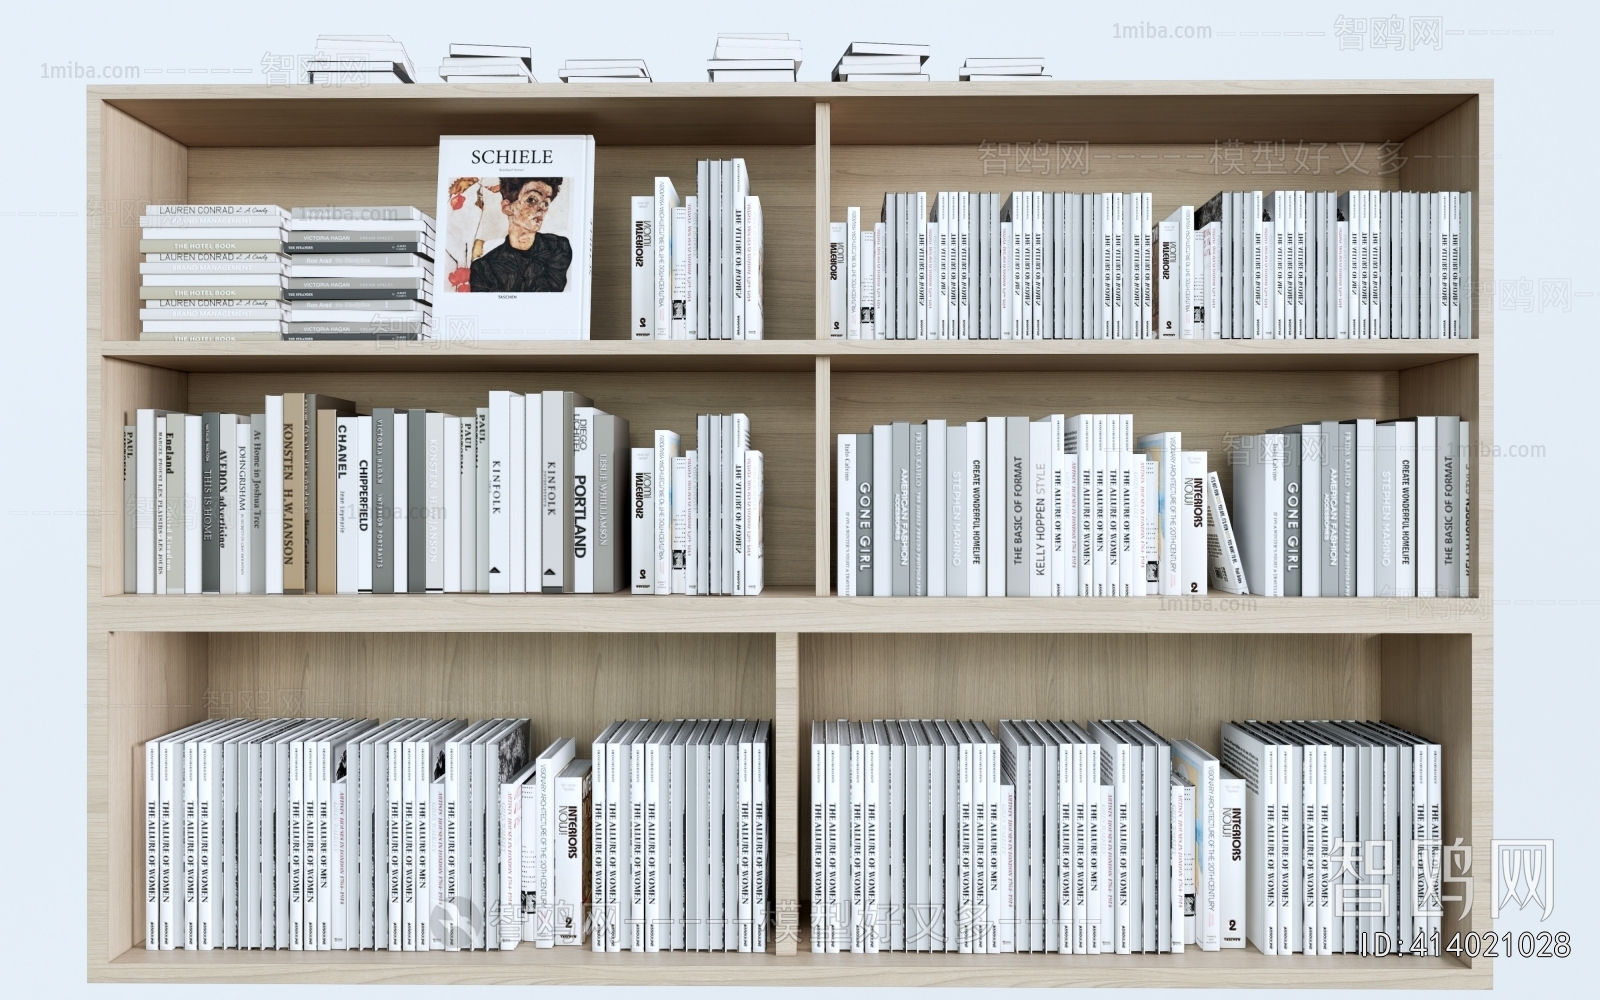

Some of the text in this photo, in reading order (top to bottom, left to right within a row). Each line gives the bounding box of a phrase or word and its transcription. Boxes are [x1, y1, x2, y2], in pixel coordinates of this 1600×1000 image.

[472, 150, 554, 164] SCHIELE
[254, 430, 261, 440] At
[284, 424, 293, 480] KONSTEN
[338, 425, 347, 479] CHANEL
[428, 439, 437, 489] KONSTEN
[493, 461, 501, 514] KINFOLK
[548, 462, 556, 516] KINFOLK
[204, 496, 212, 506] IS
[252, 479, 261, 508] Joshua
[359, 460, 368, 531] CHIPPERFIELD
[575, 476, 586, 558] PORTLAND
[952, 471, 961, 567] STEPHEN MARINO
[1014, 456, 1022, 565] THE BASIC OF FORMAT
[1193, 478, 1202, 527] INTERIORS
[1330, 468, 1338, 566] AMERICAN FASHION
[1382, 471, 1390, 567] STEPHEN MARINO
[1445, 456, 1453, 565] THE BASIC OF FORMAT
[860, 482, 871, 571] GONE GIRL
[1036, 464, 1045, 576] KELLY HOPPEN STYLE
[1055, 521, 1061, 532] OF
[1110, 521, 1117, 532] OF
[1287, 482, 1298, 571] GONE GIRL
[1191, 582, 1198, 592] 2
[568, 806, 577, 859] INTERIORS
[1232, 808, 1241, 862] INTERIORS
[148, 855, 156, 868] OF
[320, 855, 327, 868] OF
[648, 856, 655, 869] OF
[868, 857, 875, 870] OF
[1282, 859, 1289, 871] OF
[566, 918, 572, 928] 2
[1229, 920, 1236, 931] 2
